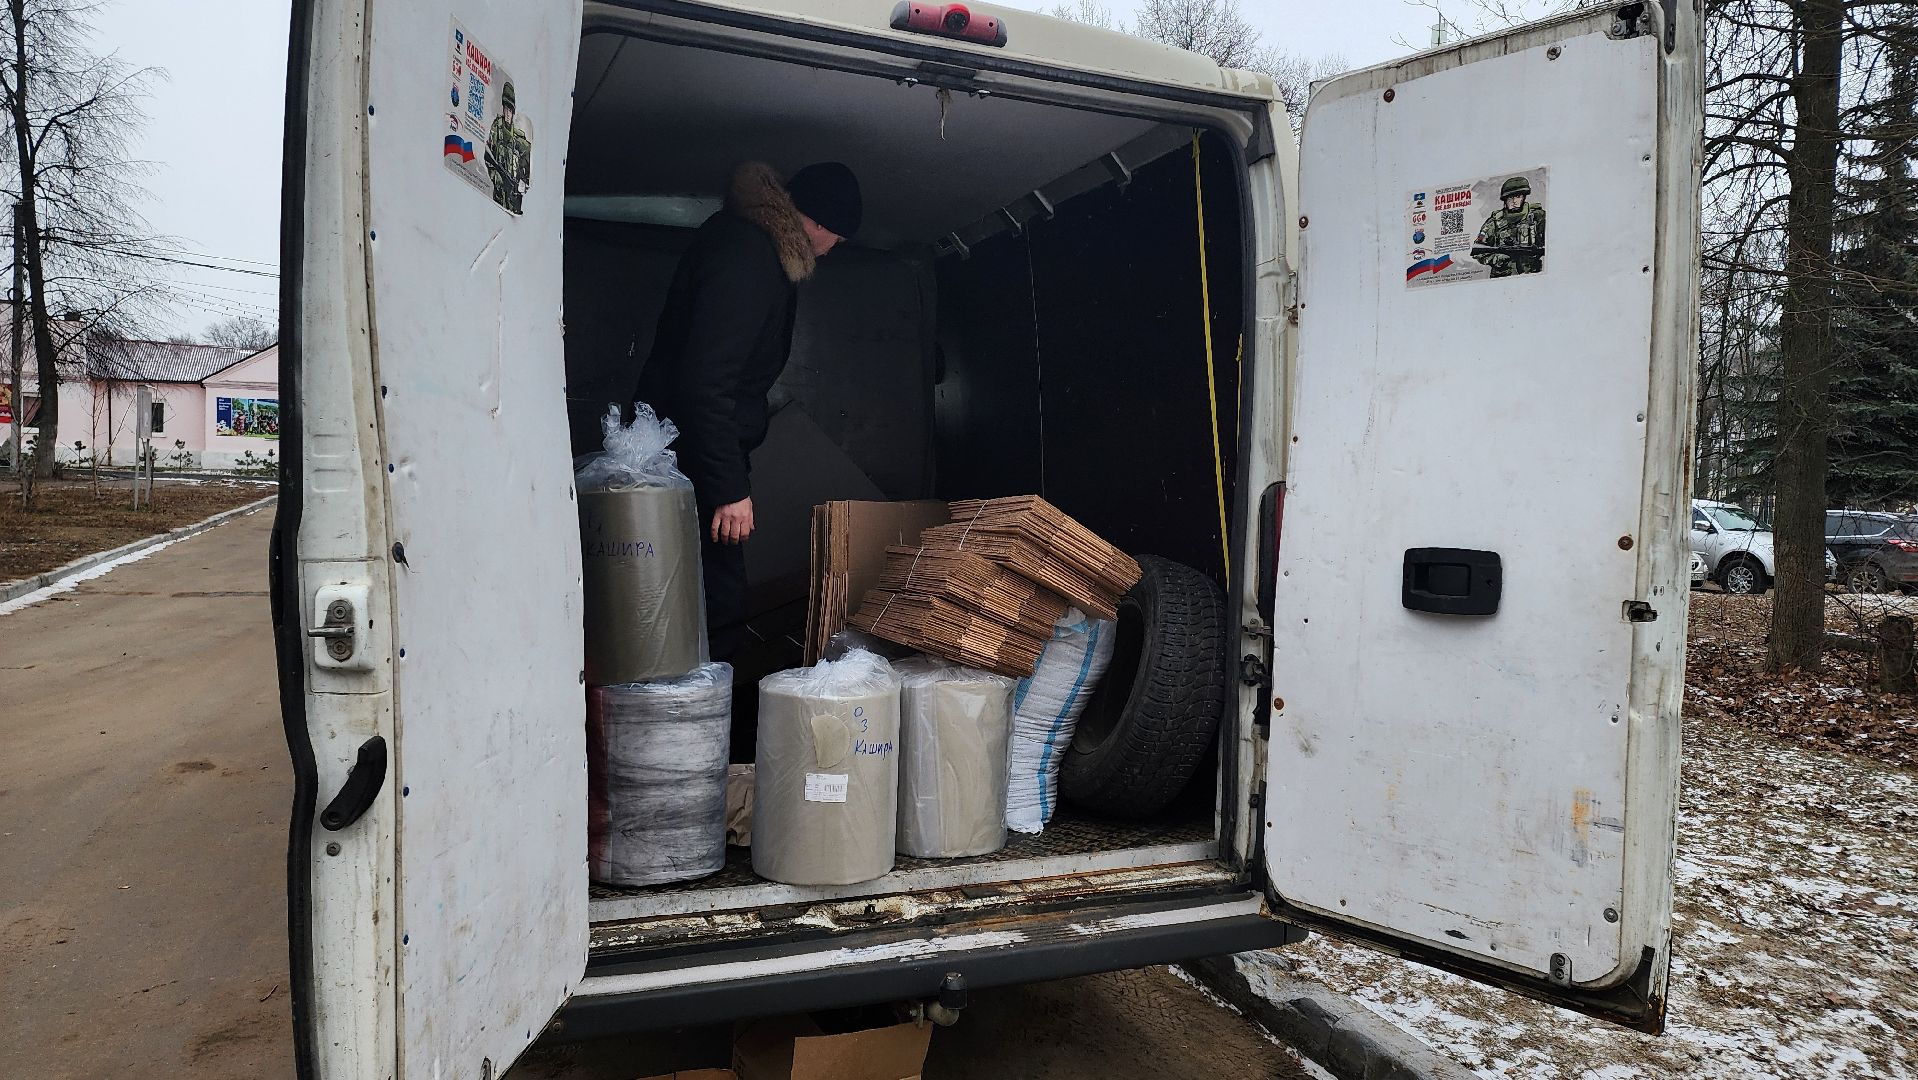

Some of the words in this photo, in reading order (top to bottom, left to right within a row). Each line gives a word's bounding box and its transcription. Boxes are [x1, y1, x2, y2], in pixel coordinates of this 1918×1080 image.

[466, 40, 491, 76] КАШИРА
[1434, 190, 1472, 206] КАШИРА
[587, 541, 655, 558] КАШИРА
